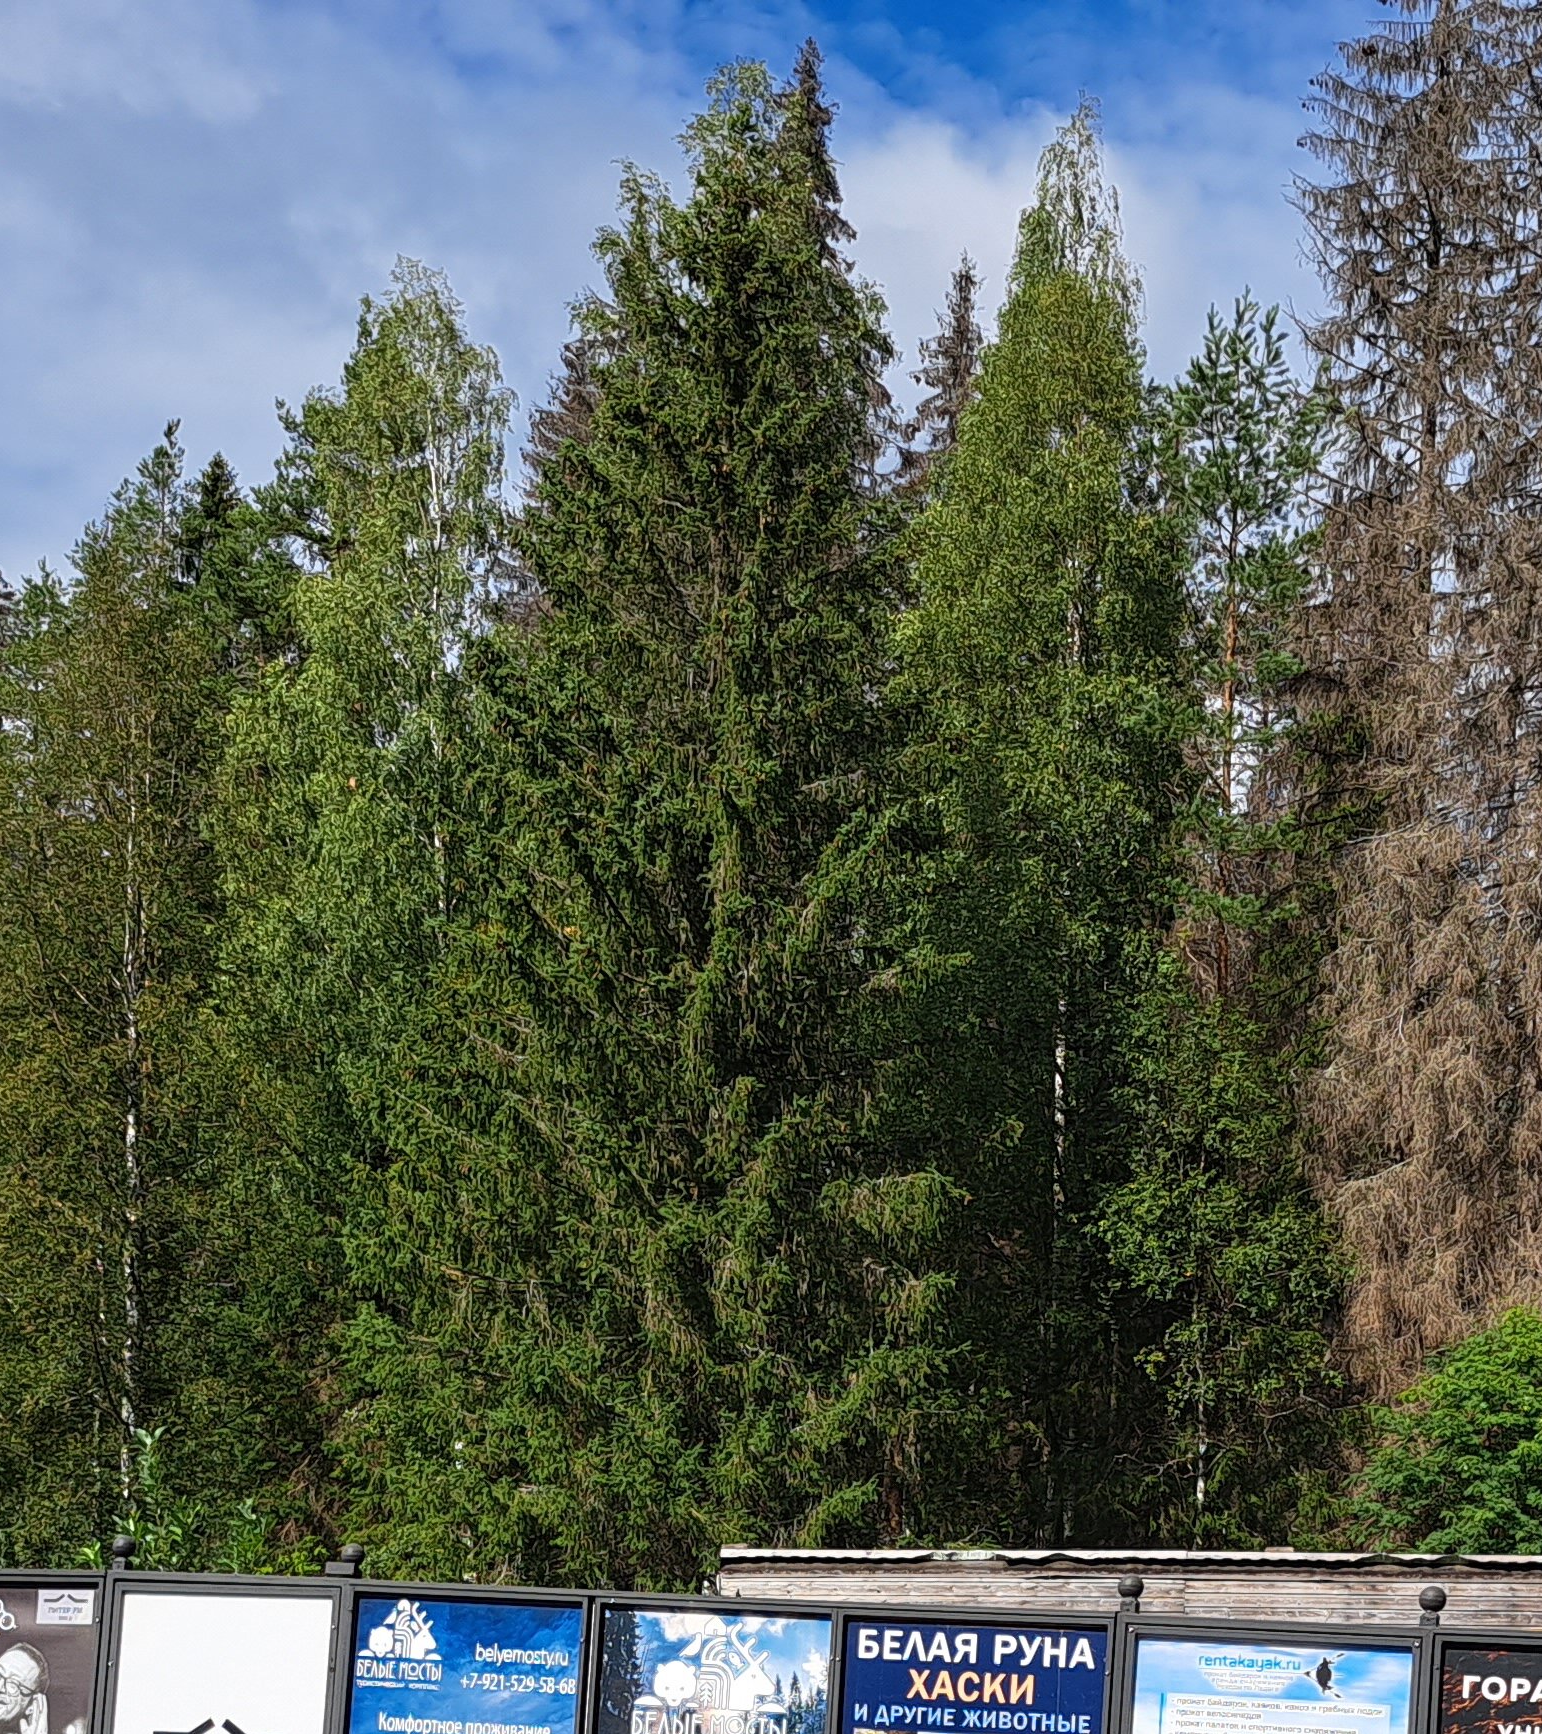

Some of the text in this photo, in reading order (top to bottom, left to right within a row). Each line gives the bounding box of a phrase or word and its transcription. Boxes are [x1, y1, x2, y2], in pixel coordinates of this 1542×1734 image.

[475, 1640, 569, 1668] belyemosty.ru
[857, 1628, 1095, 1670] БЕЛАЯ РУНА
[1198, 1653, 1301, 1672] rentakayak.ru
[356, 1659, 443, 1682] БЕЛЫЕ МОСТЫ
[460, 1672, 576, 1695] +7-921-529-58-68
[906, 1668, 1035, 1706] ХАСКИ
[853, 1704, 1092, 1734] И ДРУГИЕ ЖИВОТНЫЕ
